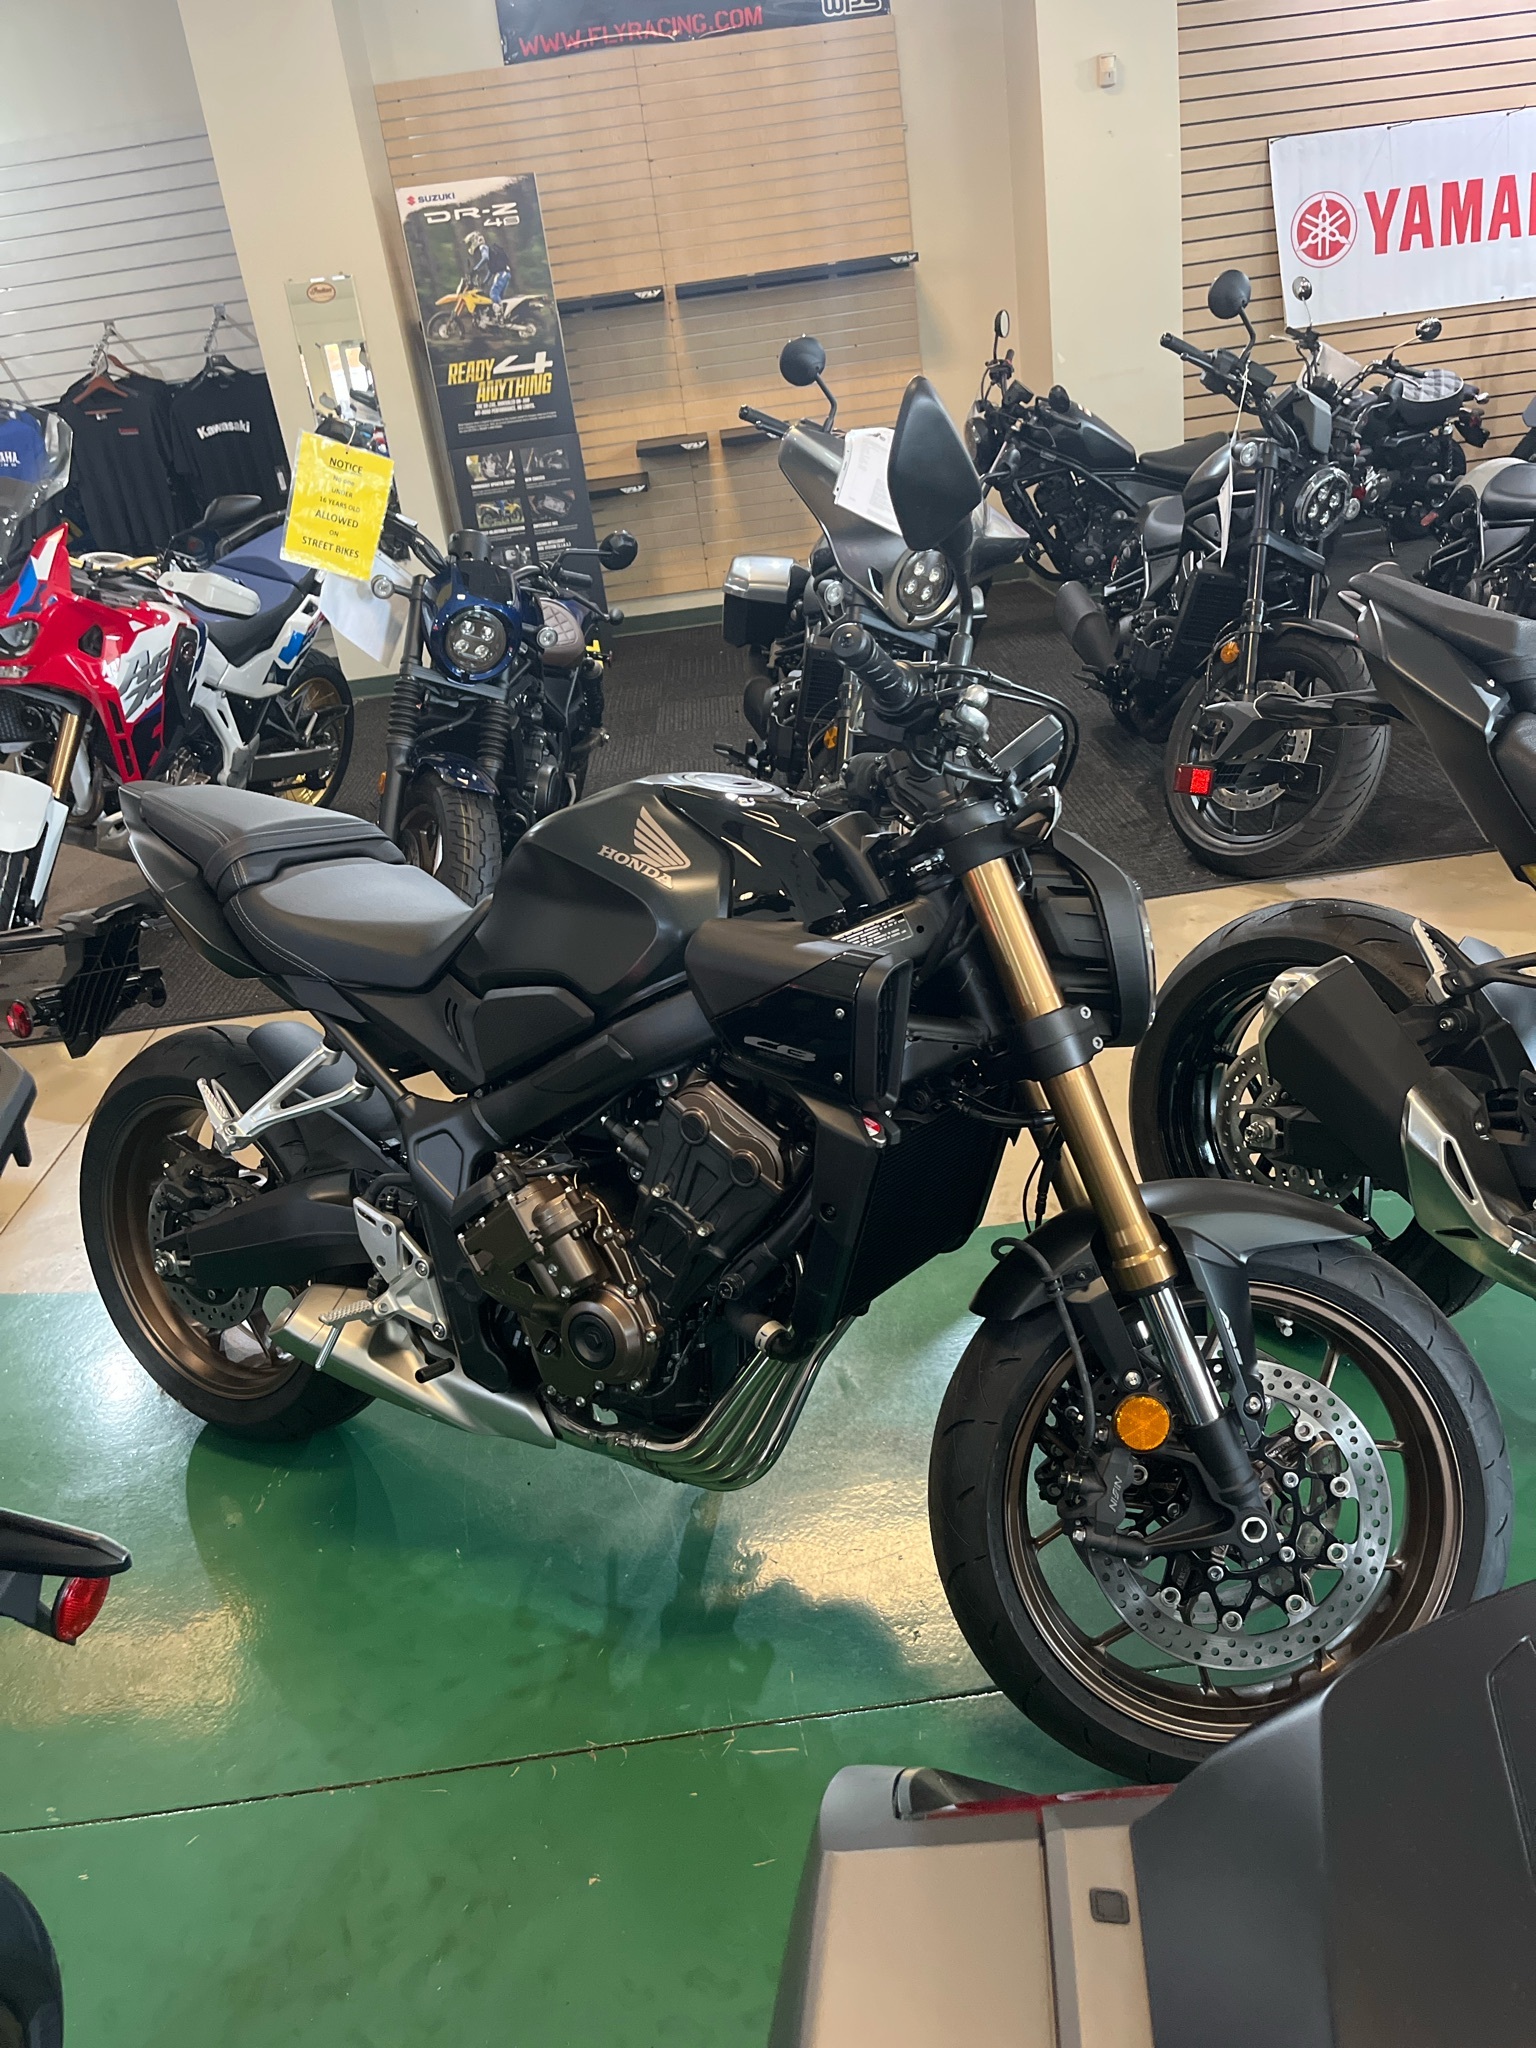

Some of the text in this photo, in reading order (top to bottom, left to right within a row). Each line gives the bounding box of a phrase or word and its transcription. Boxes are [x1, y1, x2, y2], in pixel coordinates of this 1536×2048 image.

[518, 5, 763, 58] WWW.FLYRACING.COM
[417, 192, 455, 203] SUZUKI
[424, 202, 518, 224] DR-Z
[1364, 172, 1536, 255] YAMA
[447, 351, 554, 385] READY 4
[476, 372, 553, 403] ANYTHING
[196, 420, 251, 440] Kawasaki
[329, 457, 364, 475] NOTICE
[331, 487, 353, 499] UNDER
[328, 497, 347, 510] YEARS
[347, 503, 361, 513] OLD
[314, 509, 359, 528] ALLOWED
[329, 529, 339, 537] ON
[301, 535, 359, 559] STREET BIKES
[597, 845, 674, 889] HONDA
